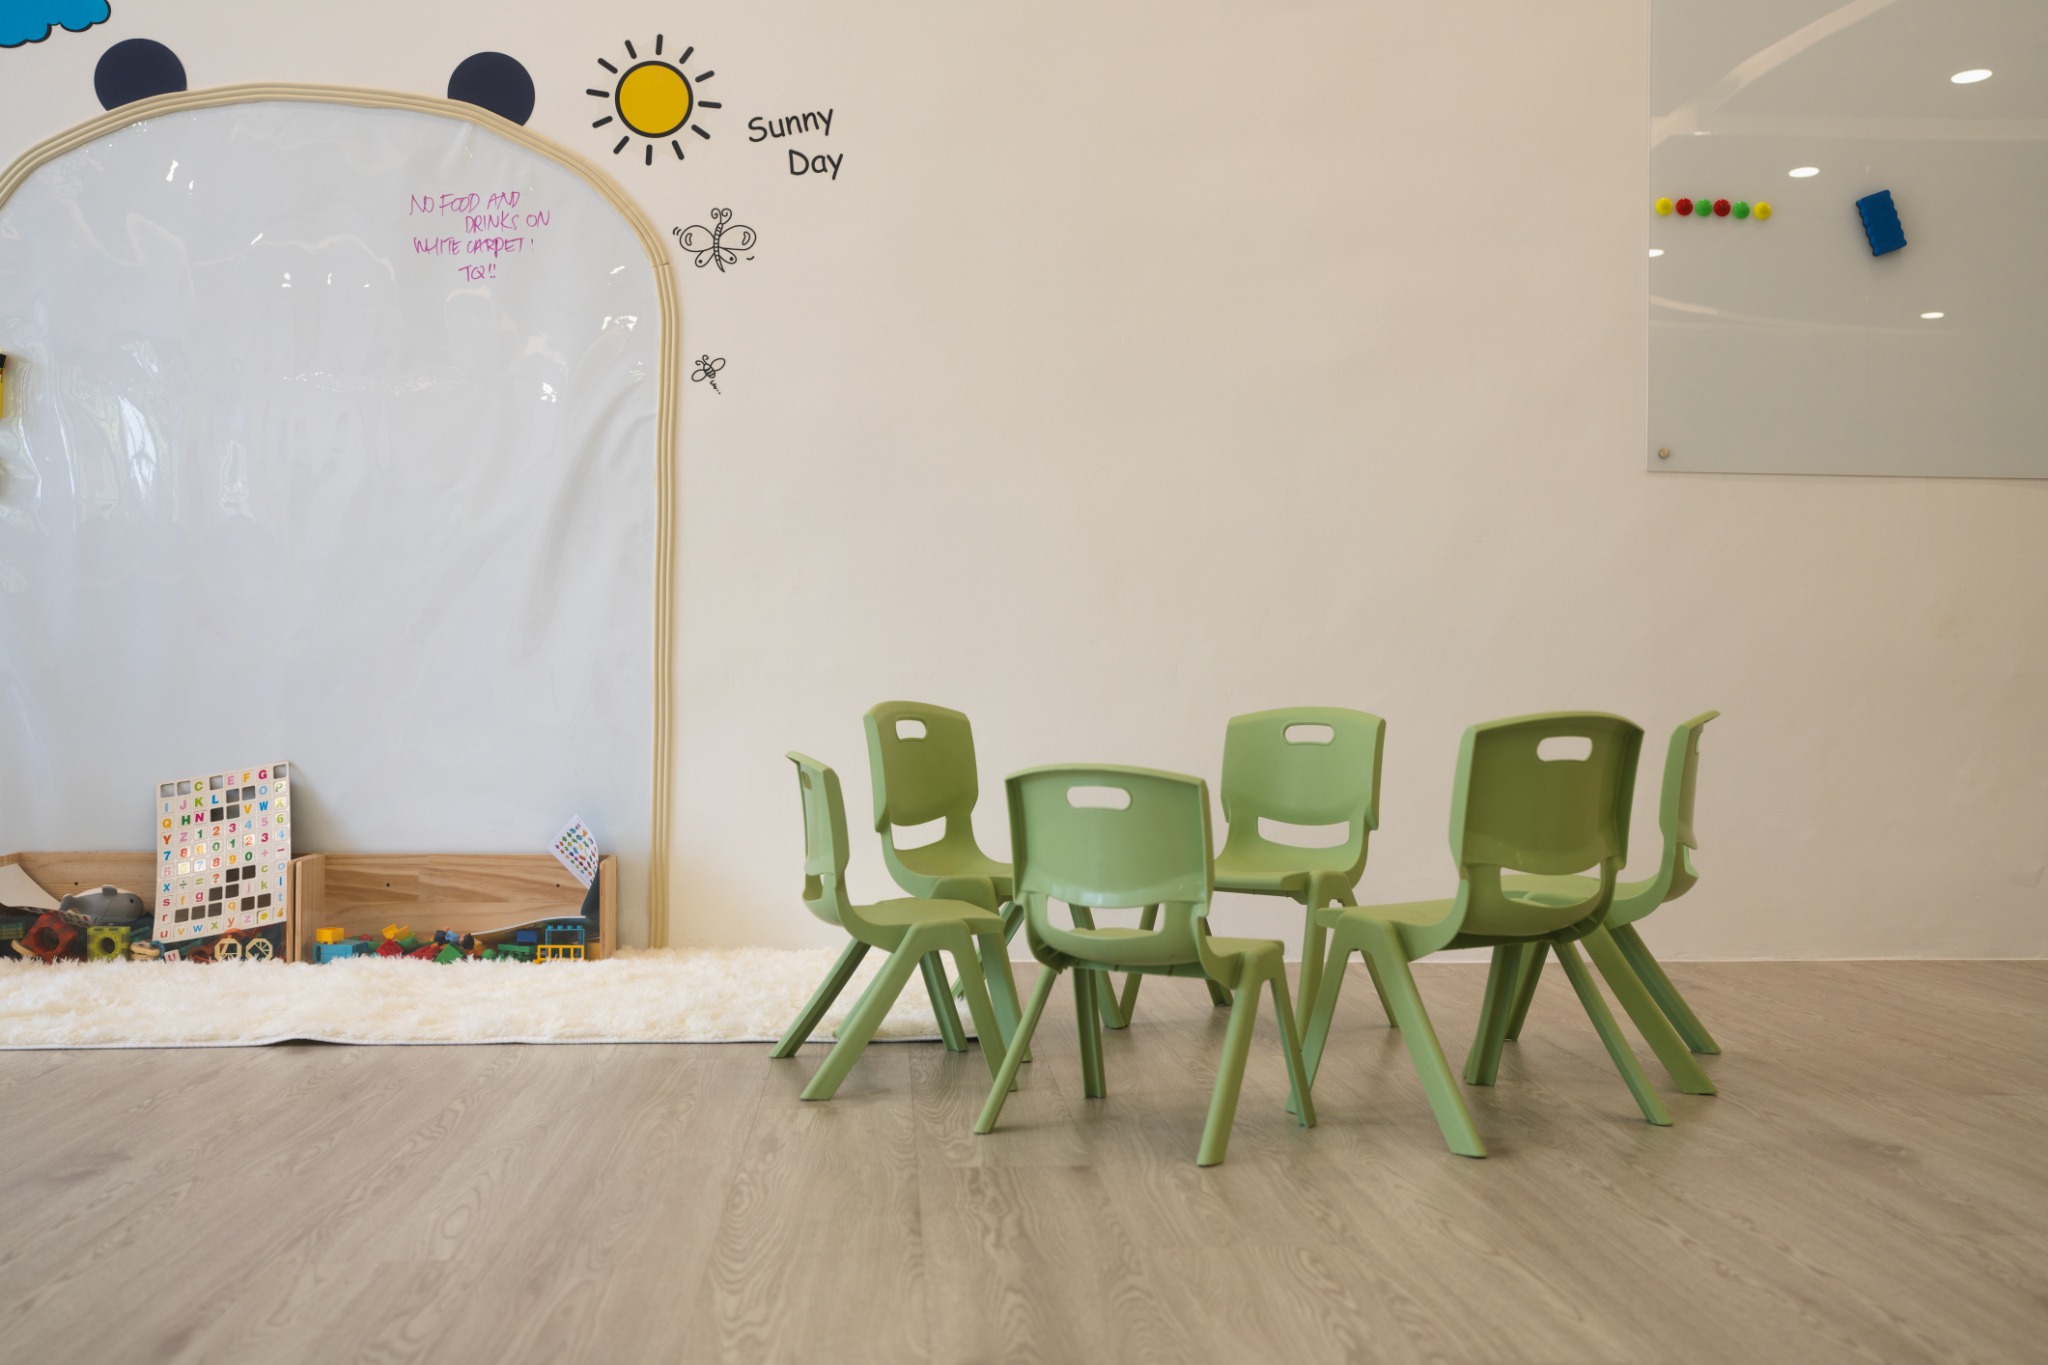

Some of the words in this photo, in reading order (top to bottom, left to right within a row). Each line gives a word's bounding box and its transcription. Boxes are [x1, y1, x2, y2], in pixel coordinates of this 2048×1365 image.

[748, 108, 833, 142] Sunny
[788, 149, 843, 181] Day
[409, 194, 435, 215] NO
[439, 193, 480, 216] FOOD
[486, 191, 520, 210] AND
[465, 210, 519, 233] DRINKS
[526, 210, 551, 228] ON
[413, 237, 462, 256] WHITE
[458, 263, 496, 282] TQ!!
